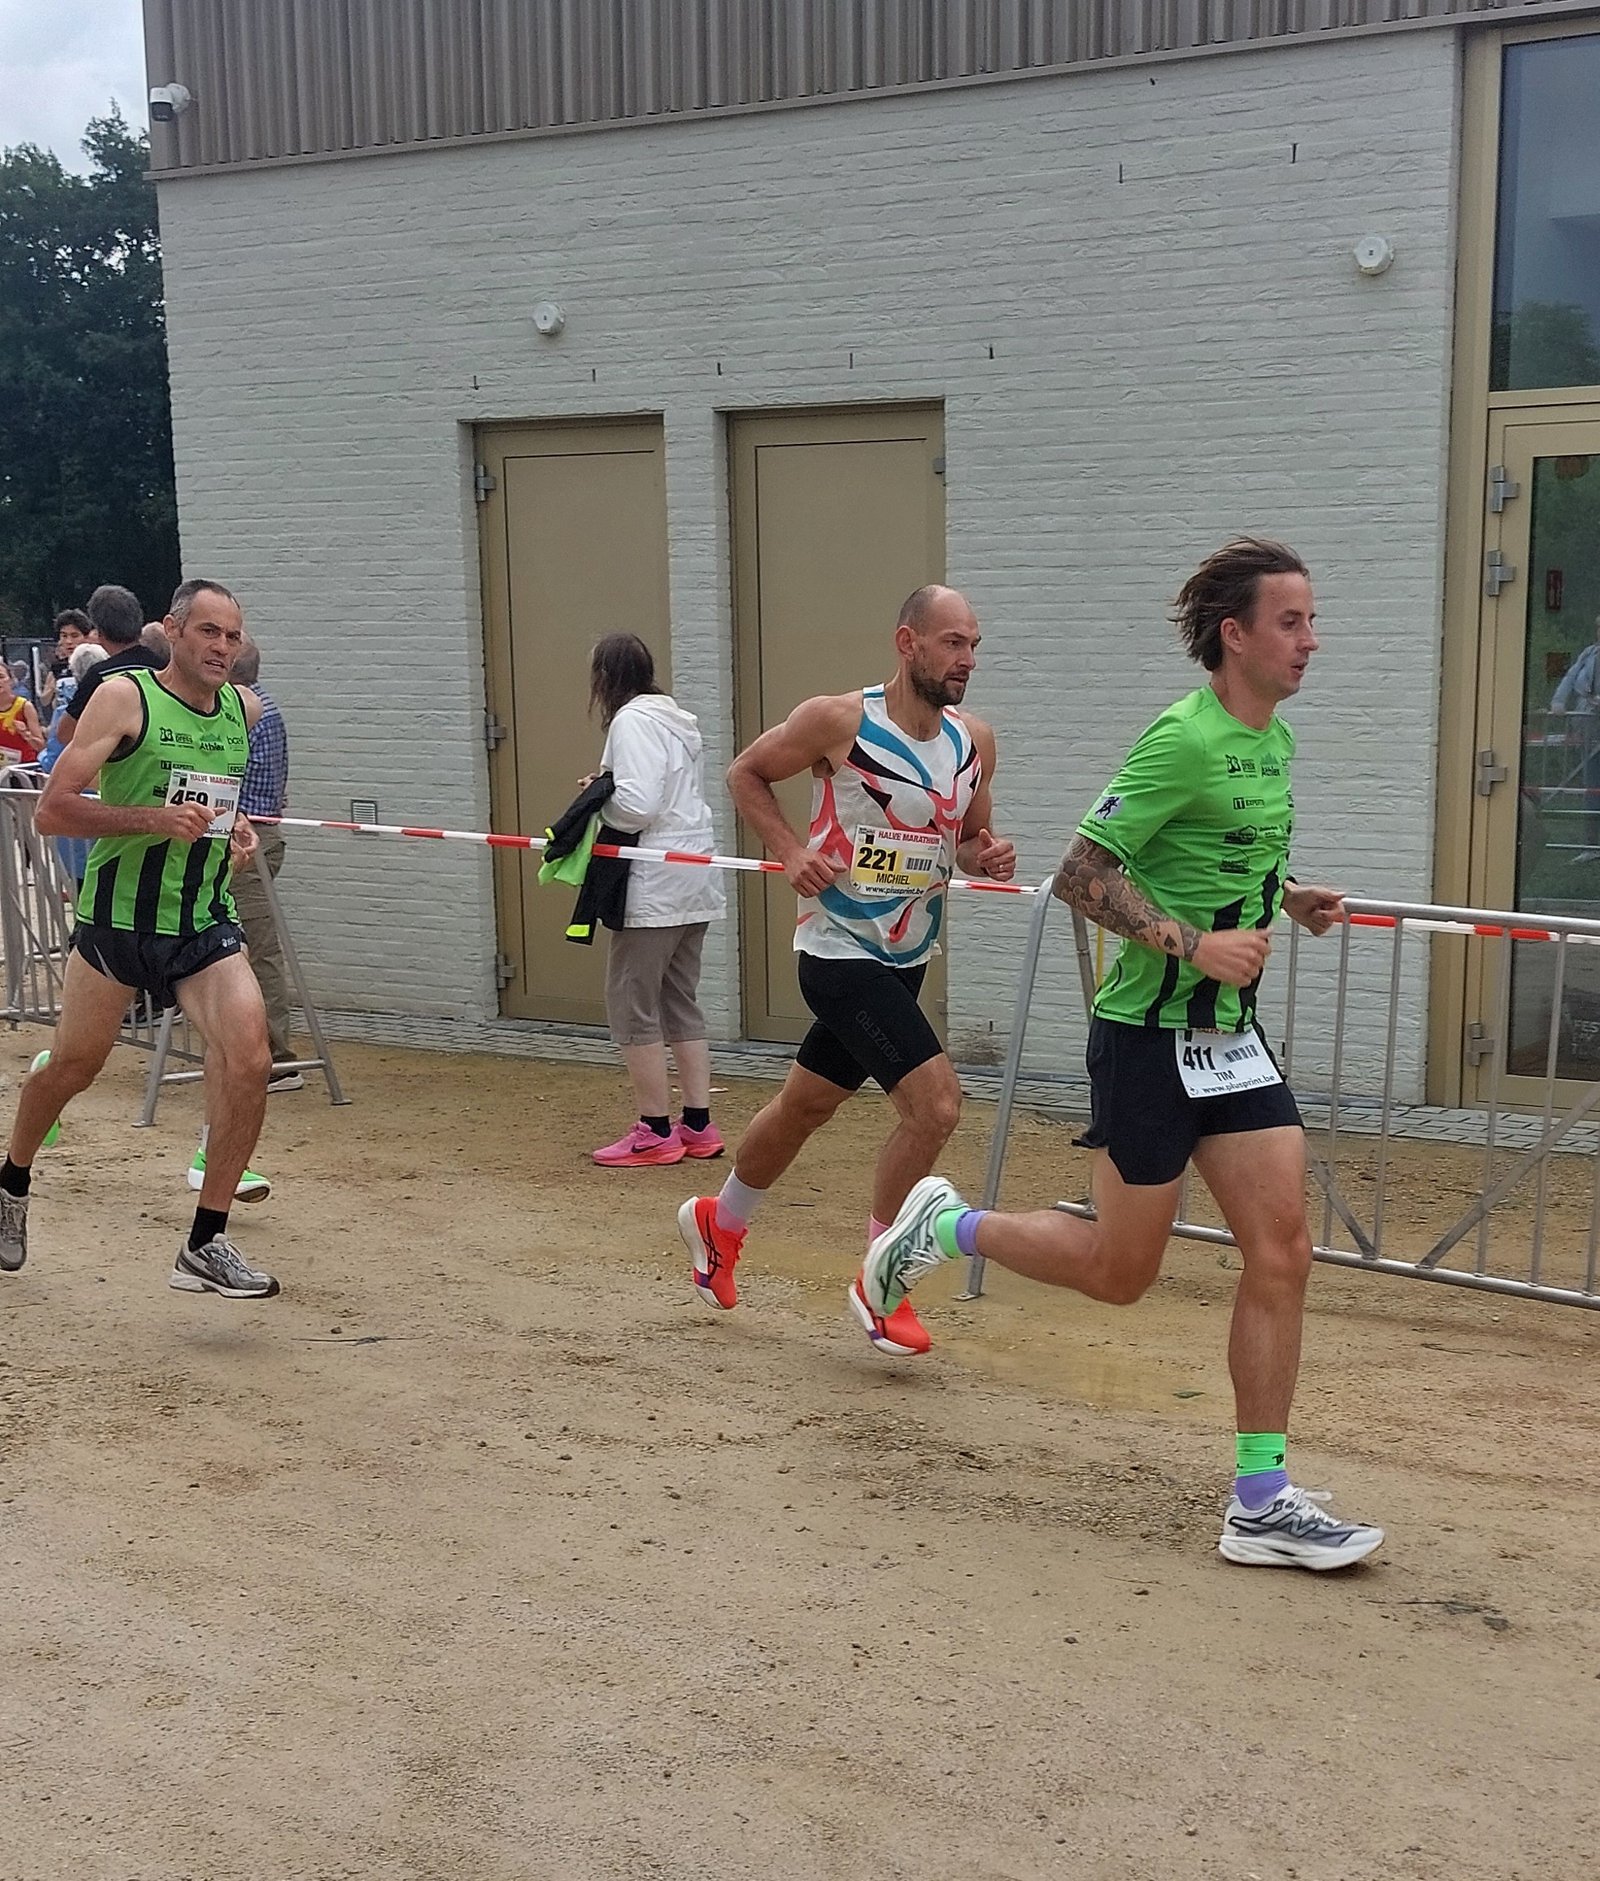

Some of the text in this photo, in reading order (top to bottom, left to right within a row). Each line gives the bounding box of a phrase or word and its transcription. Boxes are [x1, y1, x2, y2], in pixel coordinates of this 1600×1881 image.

[878, 830, 902, 840] HALVE
[902, 834, 940, 845] MARATHON
[856, 846, 898, 872] 221
[875, 872, 911, 885] MICHIEL
[865, 885, 924, 895] www.plusprint.be
[1182, 1045, 1217, 1071] 411
[1213, 1069, 1236, 1082] TIM
[1201, 1074, 1276, 1094] www.plusprint.be
